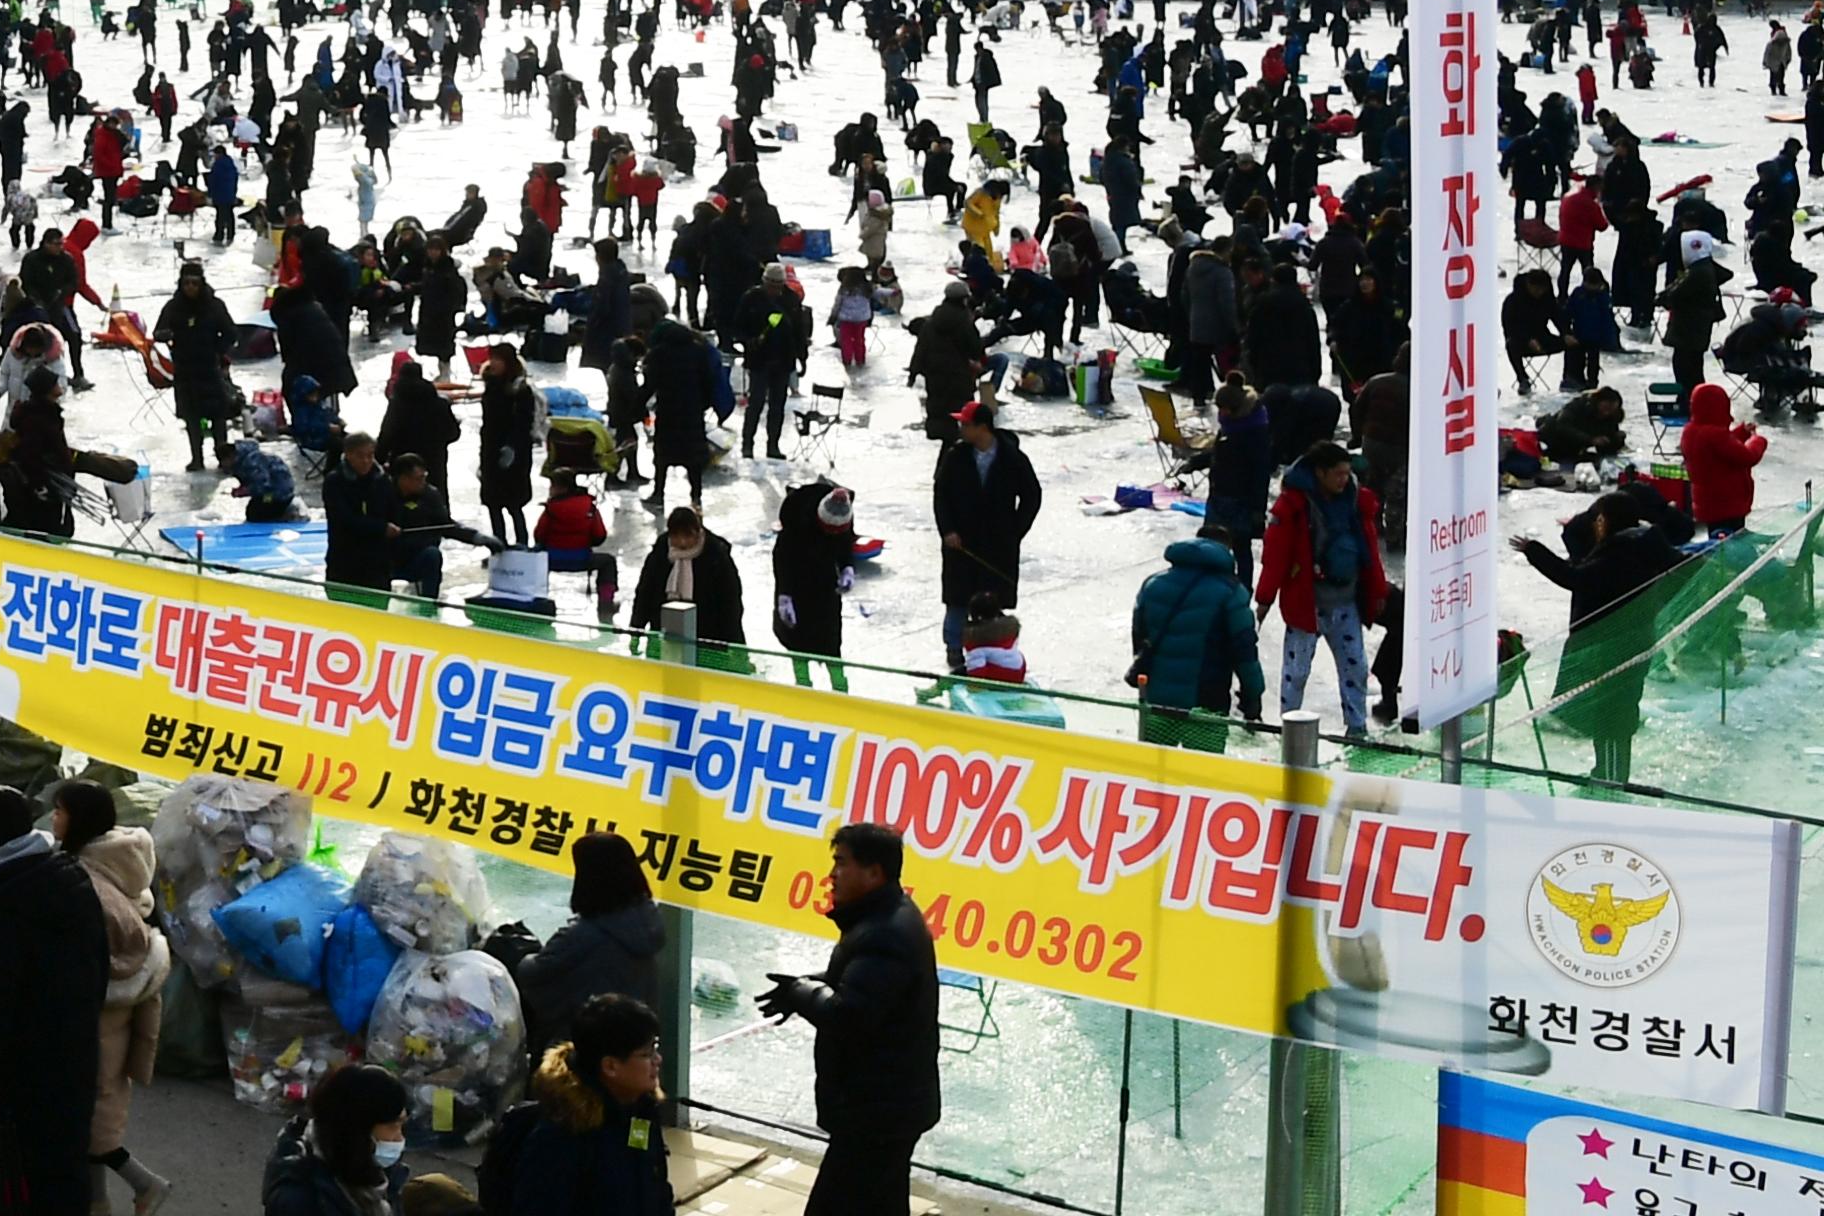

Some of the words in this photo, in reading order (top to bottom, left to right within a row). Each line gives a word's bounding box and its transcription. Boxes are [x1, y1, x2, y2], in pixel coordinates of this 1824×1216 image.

[1439, 11, 1481, 455] 화장실
[2, 568, 145, 672] 전화로
[155, 603, 425, 743] 대출권유시
[436, 660, 557, 770] 입금
[561, 689, 837, 830] 요구하면
[849, 740, 1022, 865] 100%
[1038, 776, 1487, 945] 사기입니다.
[140, 713, 285, 782] 범죄신고
[297, 752, 359, 804] 112
[637, 830, 774, 904] 지능팀
[1533, 913, 1582, 975] HWACHEON
[1584, 968, 1633, 982] POLICE
[1635, 928, 1673, 974] STATION
[1487, 994, 1737, 1065] 화천경찰서
[1632, 1137, 1767, 1192] 난타의
